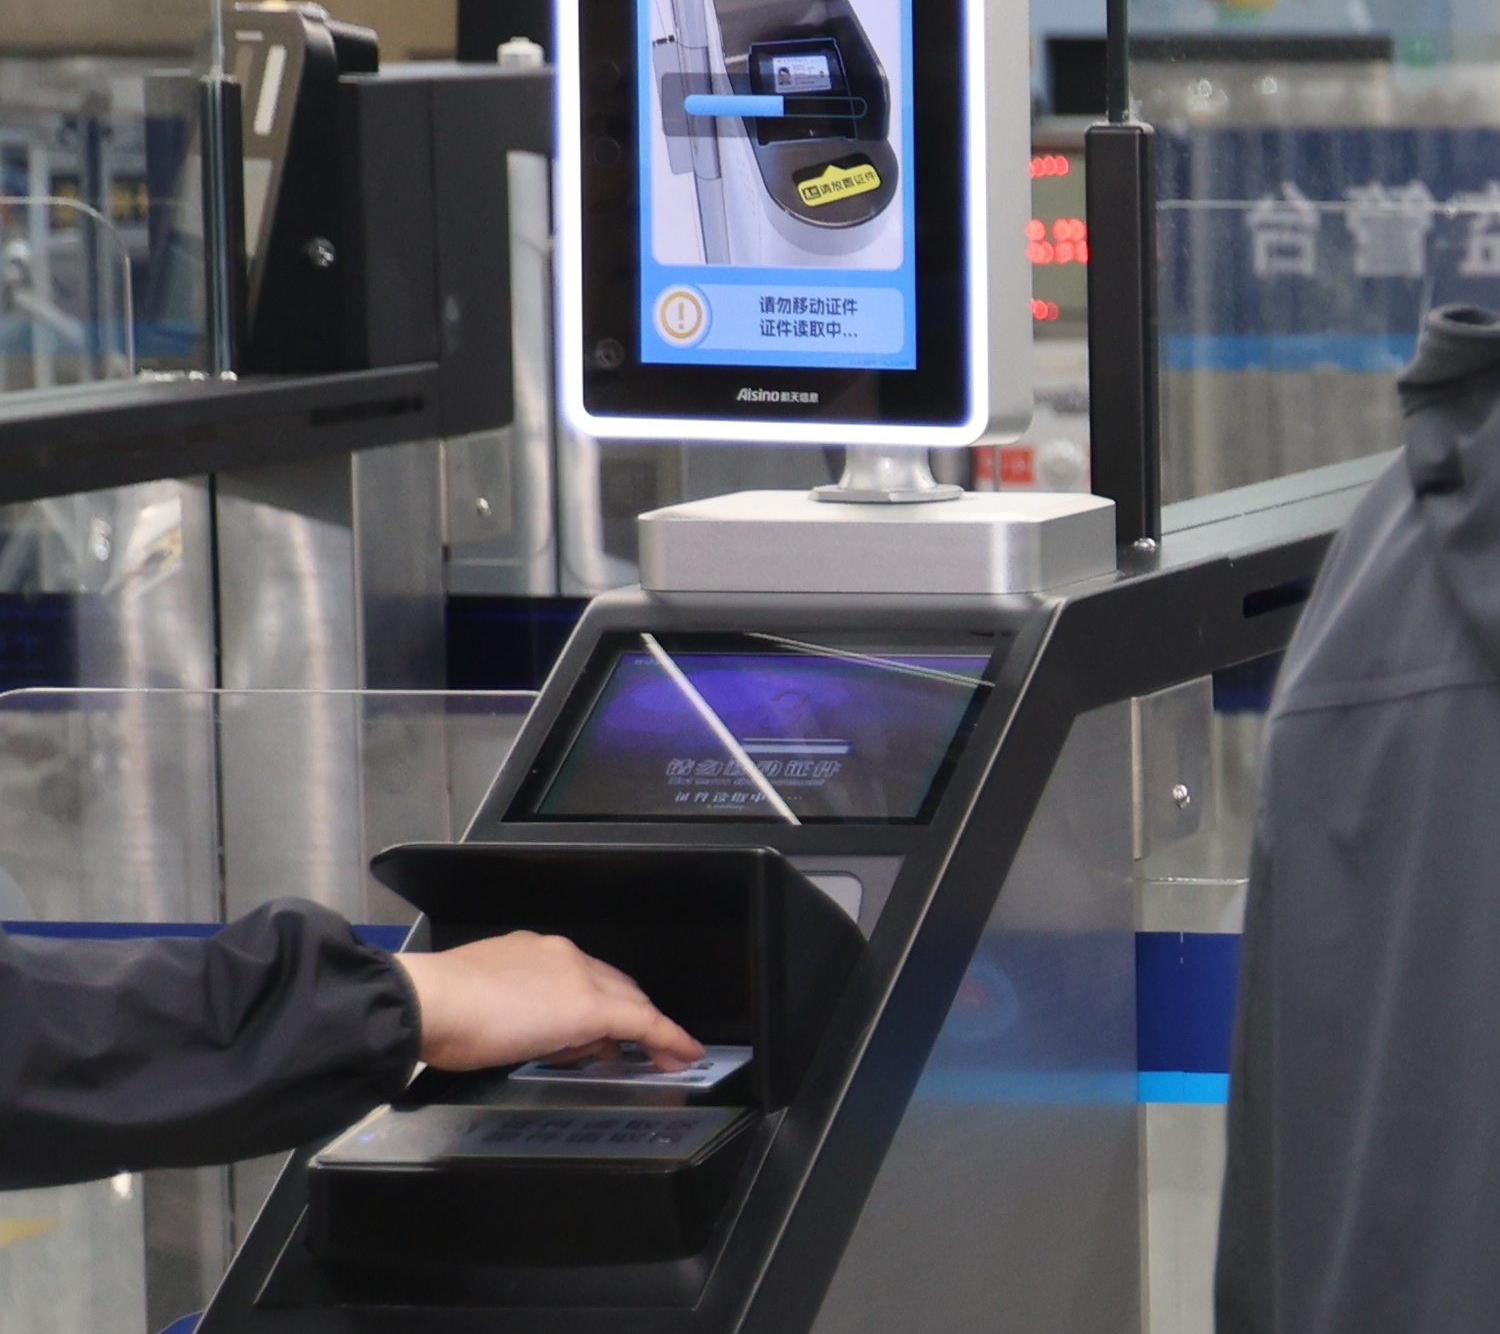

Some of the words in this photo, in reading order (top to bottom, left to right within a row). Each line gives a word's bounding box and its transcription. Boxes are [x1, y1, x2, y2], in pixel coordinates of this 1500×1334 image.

[759, 296, 858, 316] 请勿移动证件
